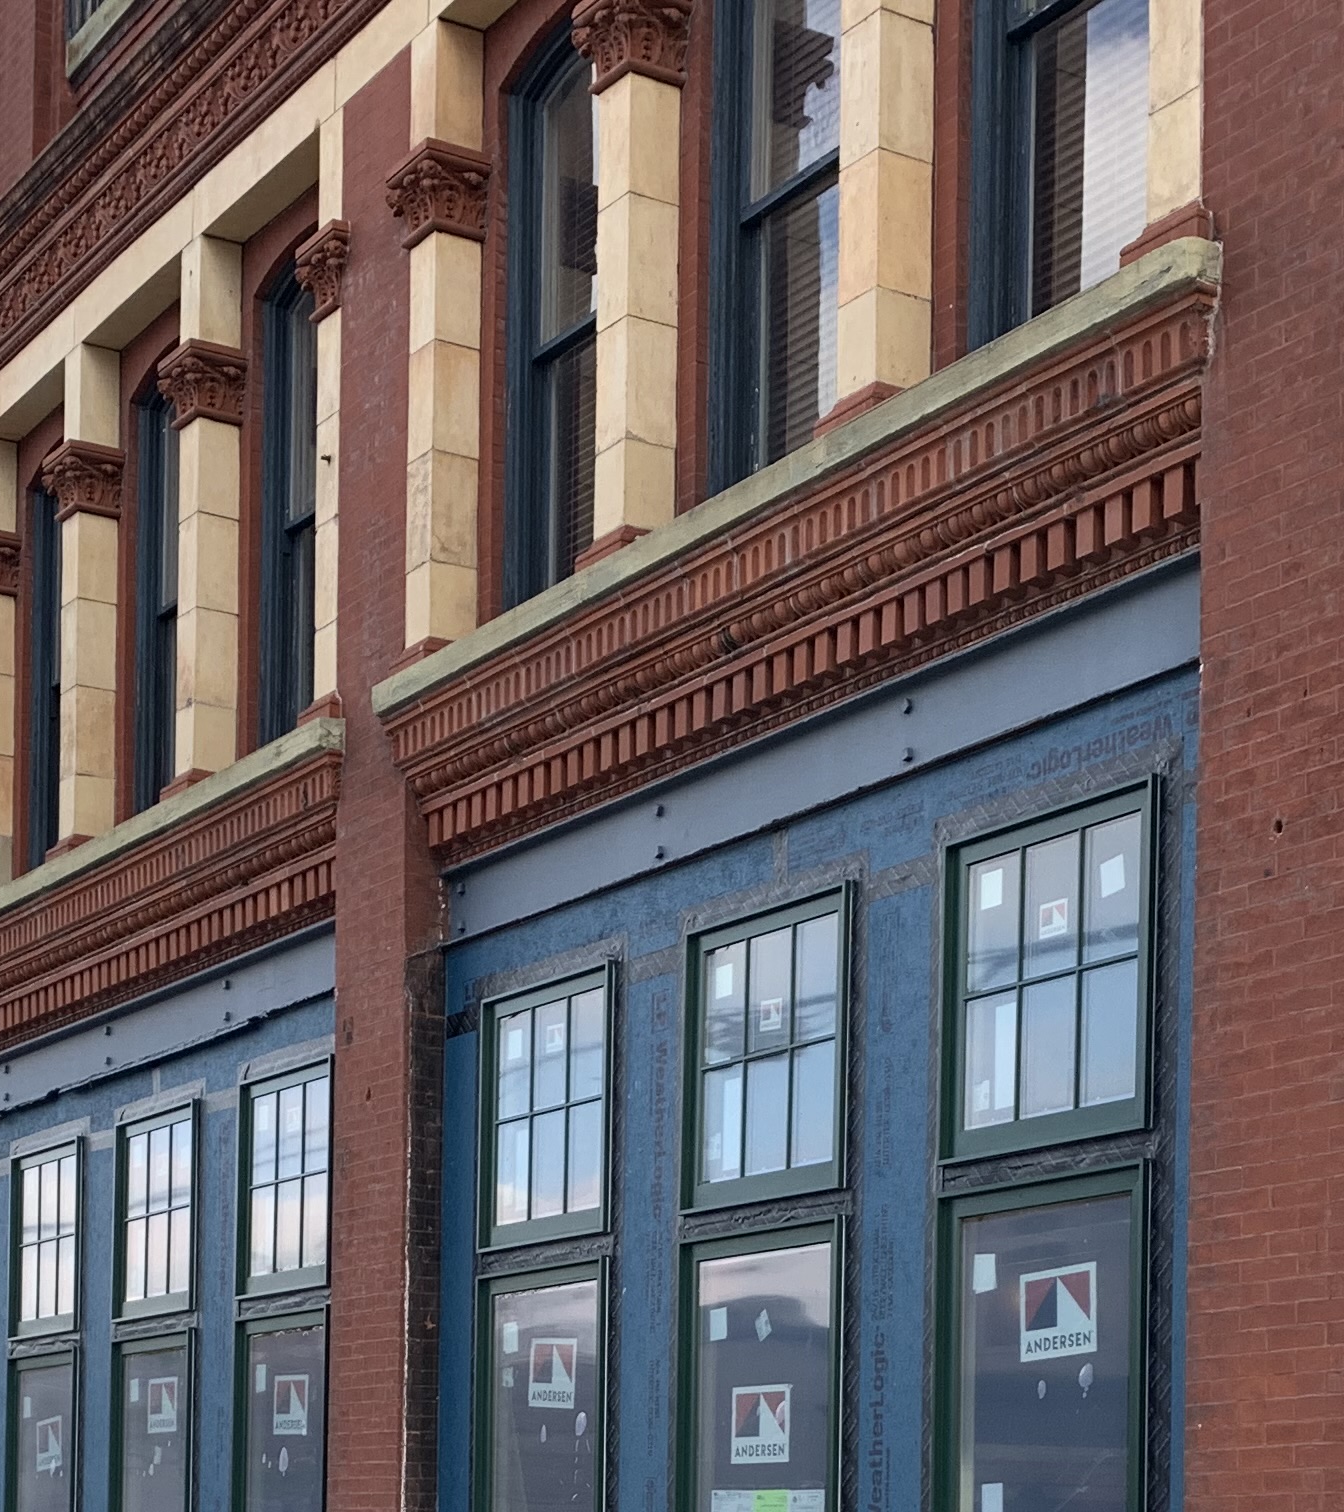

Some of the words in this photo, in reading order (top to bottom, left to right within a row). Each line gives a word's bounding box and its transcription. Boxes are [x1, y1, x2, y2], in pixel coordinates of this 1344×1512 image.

[1025, 1331, 1092, 1355] ANDERSEN
[531, 1390, 572, 1403] ANDERSEN
[734, 1443, 785, 1459] ANDERSEN
